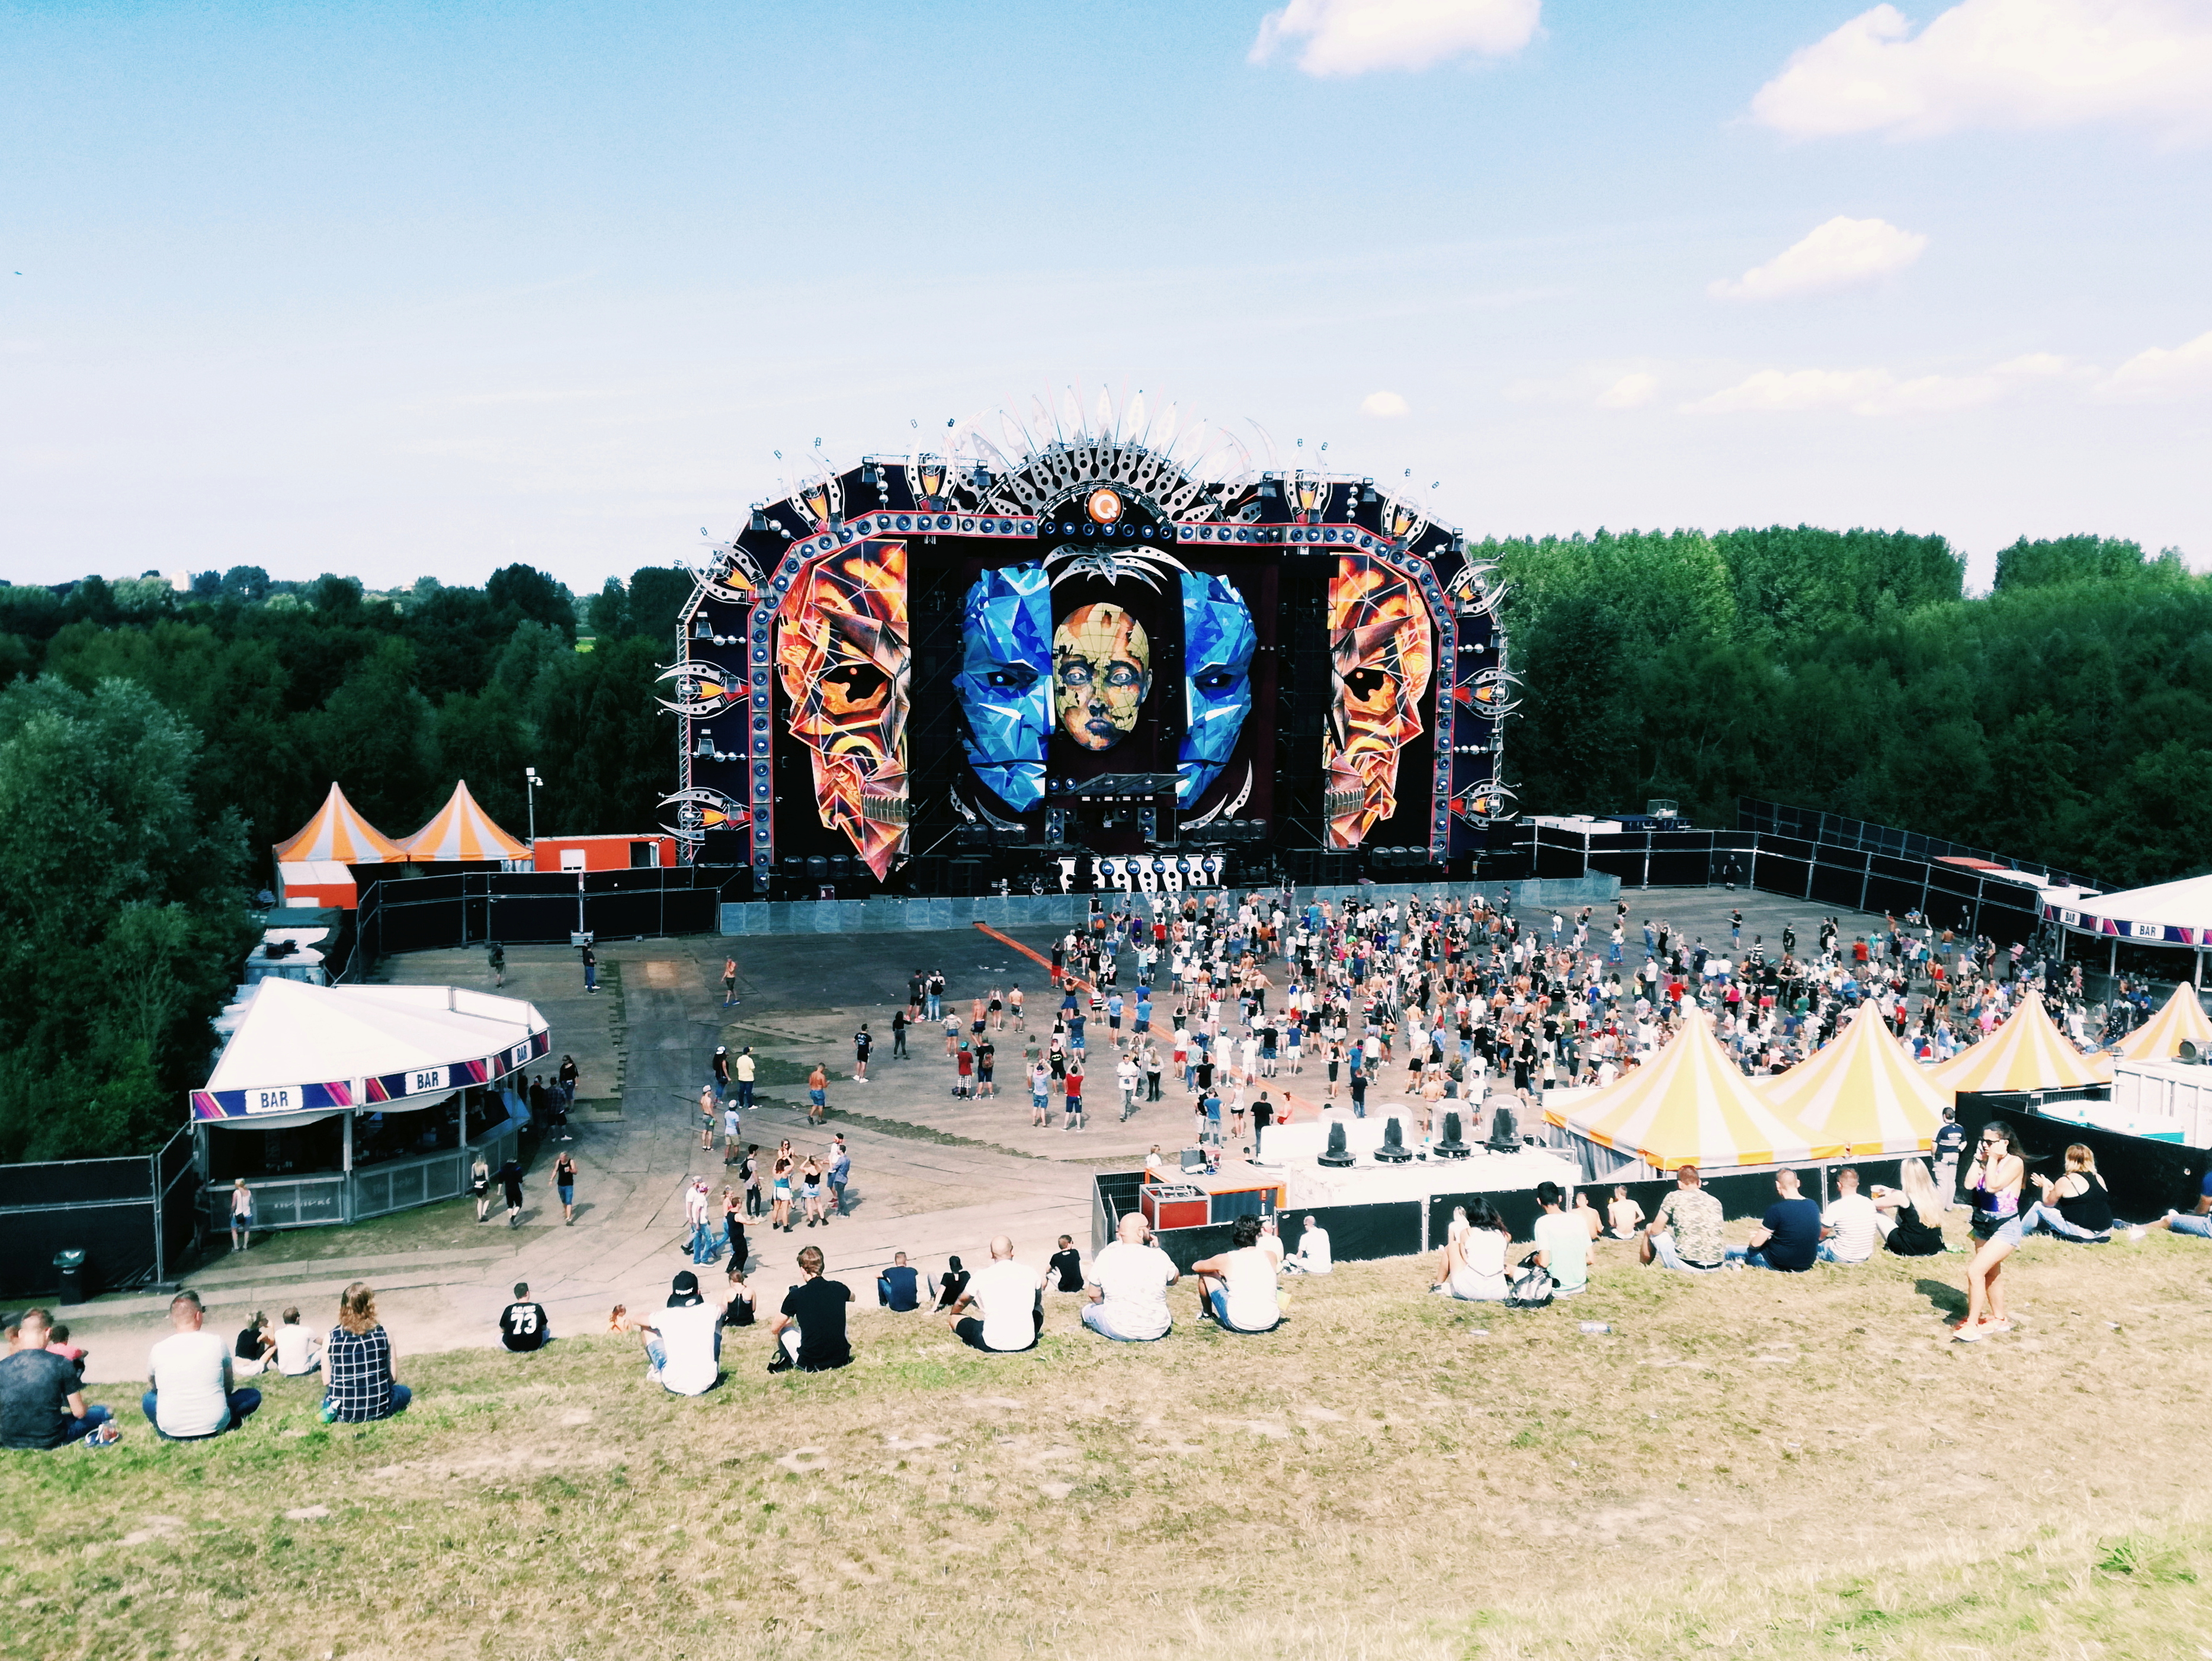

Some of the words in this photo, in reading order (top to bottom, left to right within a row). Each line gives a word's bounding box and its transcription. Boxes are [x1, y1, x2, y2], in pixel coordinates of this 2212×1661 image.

[2065, 912, 2075, 923] BAR
[2140, 925, 2156, 937] BAR
[517, 1045, 527, 1063] BAR
[417, 1071, 439, 1089] BAR
[261, 1091, 288, 1108] BAR
[511, 1313, 537, 1335] 73
